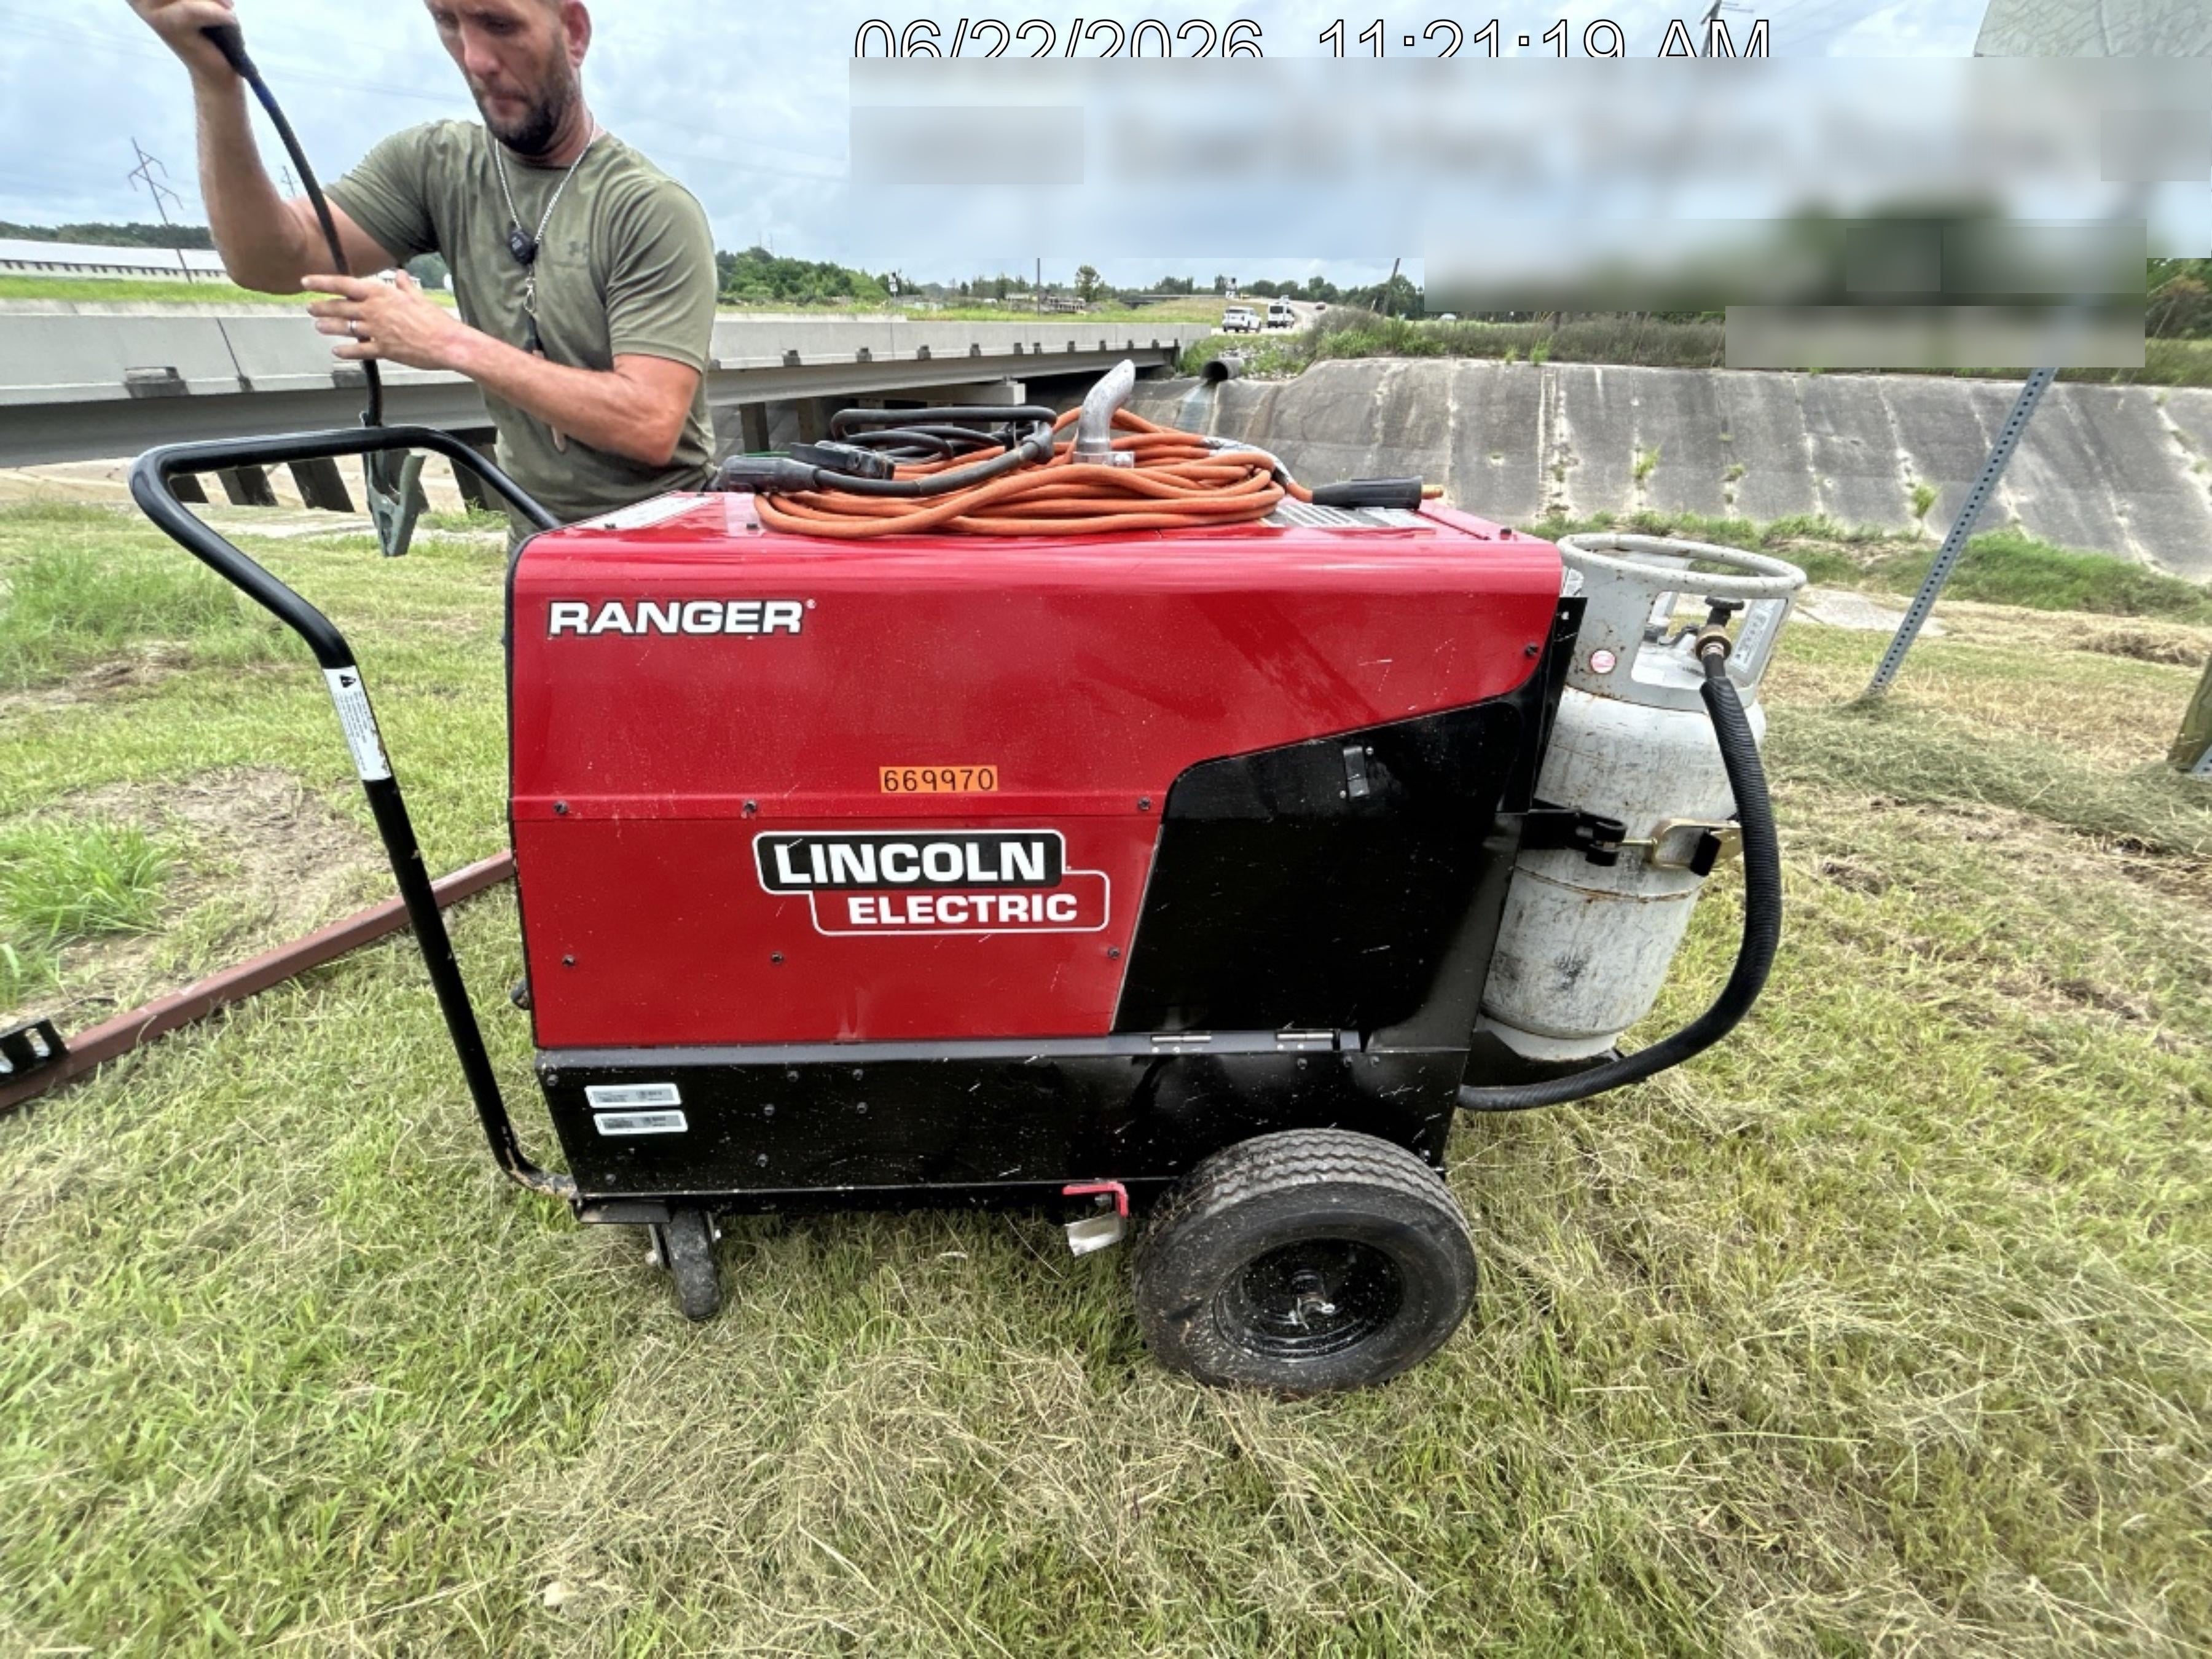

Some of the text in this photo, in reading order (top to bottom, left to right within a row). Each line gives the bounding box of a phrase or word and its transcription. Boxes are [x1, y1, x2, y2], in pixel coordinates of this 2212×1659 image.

[549, 600, 804, 635] RANGER
[884, 767, 994, 792] 669970
[773, 841, 1045, 884] LINCOLN
[847, 893, 1078, 925] ELECTRIC
